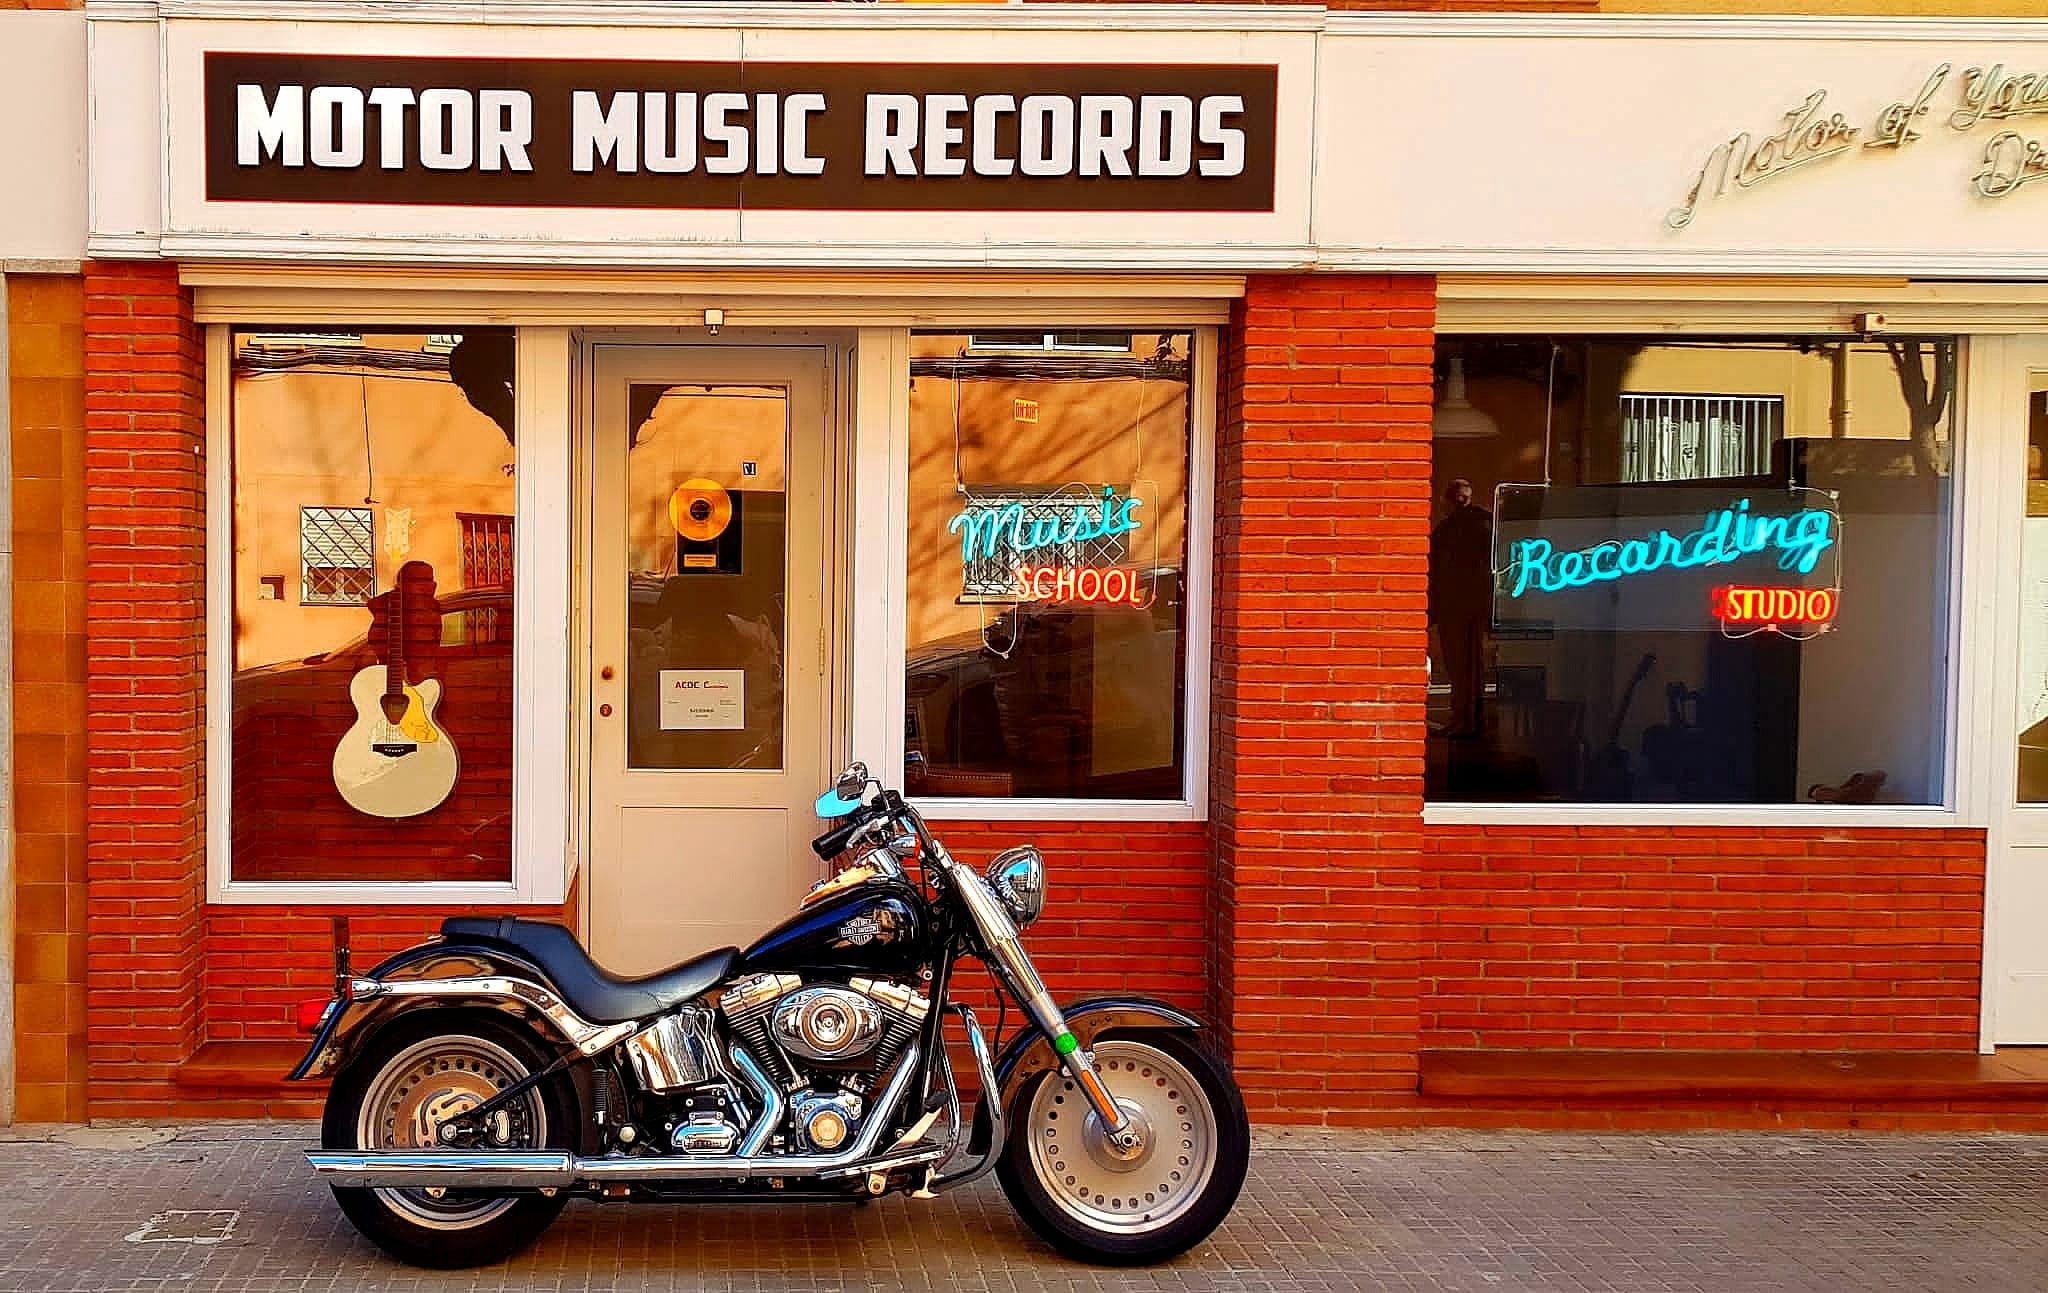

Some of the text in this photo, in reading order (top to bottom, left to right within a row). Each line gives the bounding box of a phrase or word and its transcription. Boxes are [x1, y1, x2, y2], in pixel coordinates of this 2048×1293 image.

[236, 83, 1246, 178] MOTOR MUSIC RECORDS
[1664, 87, 1862, 229] Motor
[1863, 61, 1951, 150] of
[949, 485, 1143, 563] Music
[1509, 498, 1834, 599] Recording
[1016, 564, 1142, 603] SCHOOL
[1727, 588, 1832, 621] STUDIO
